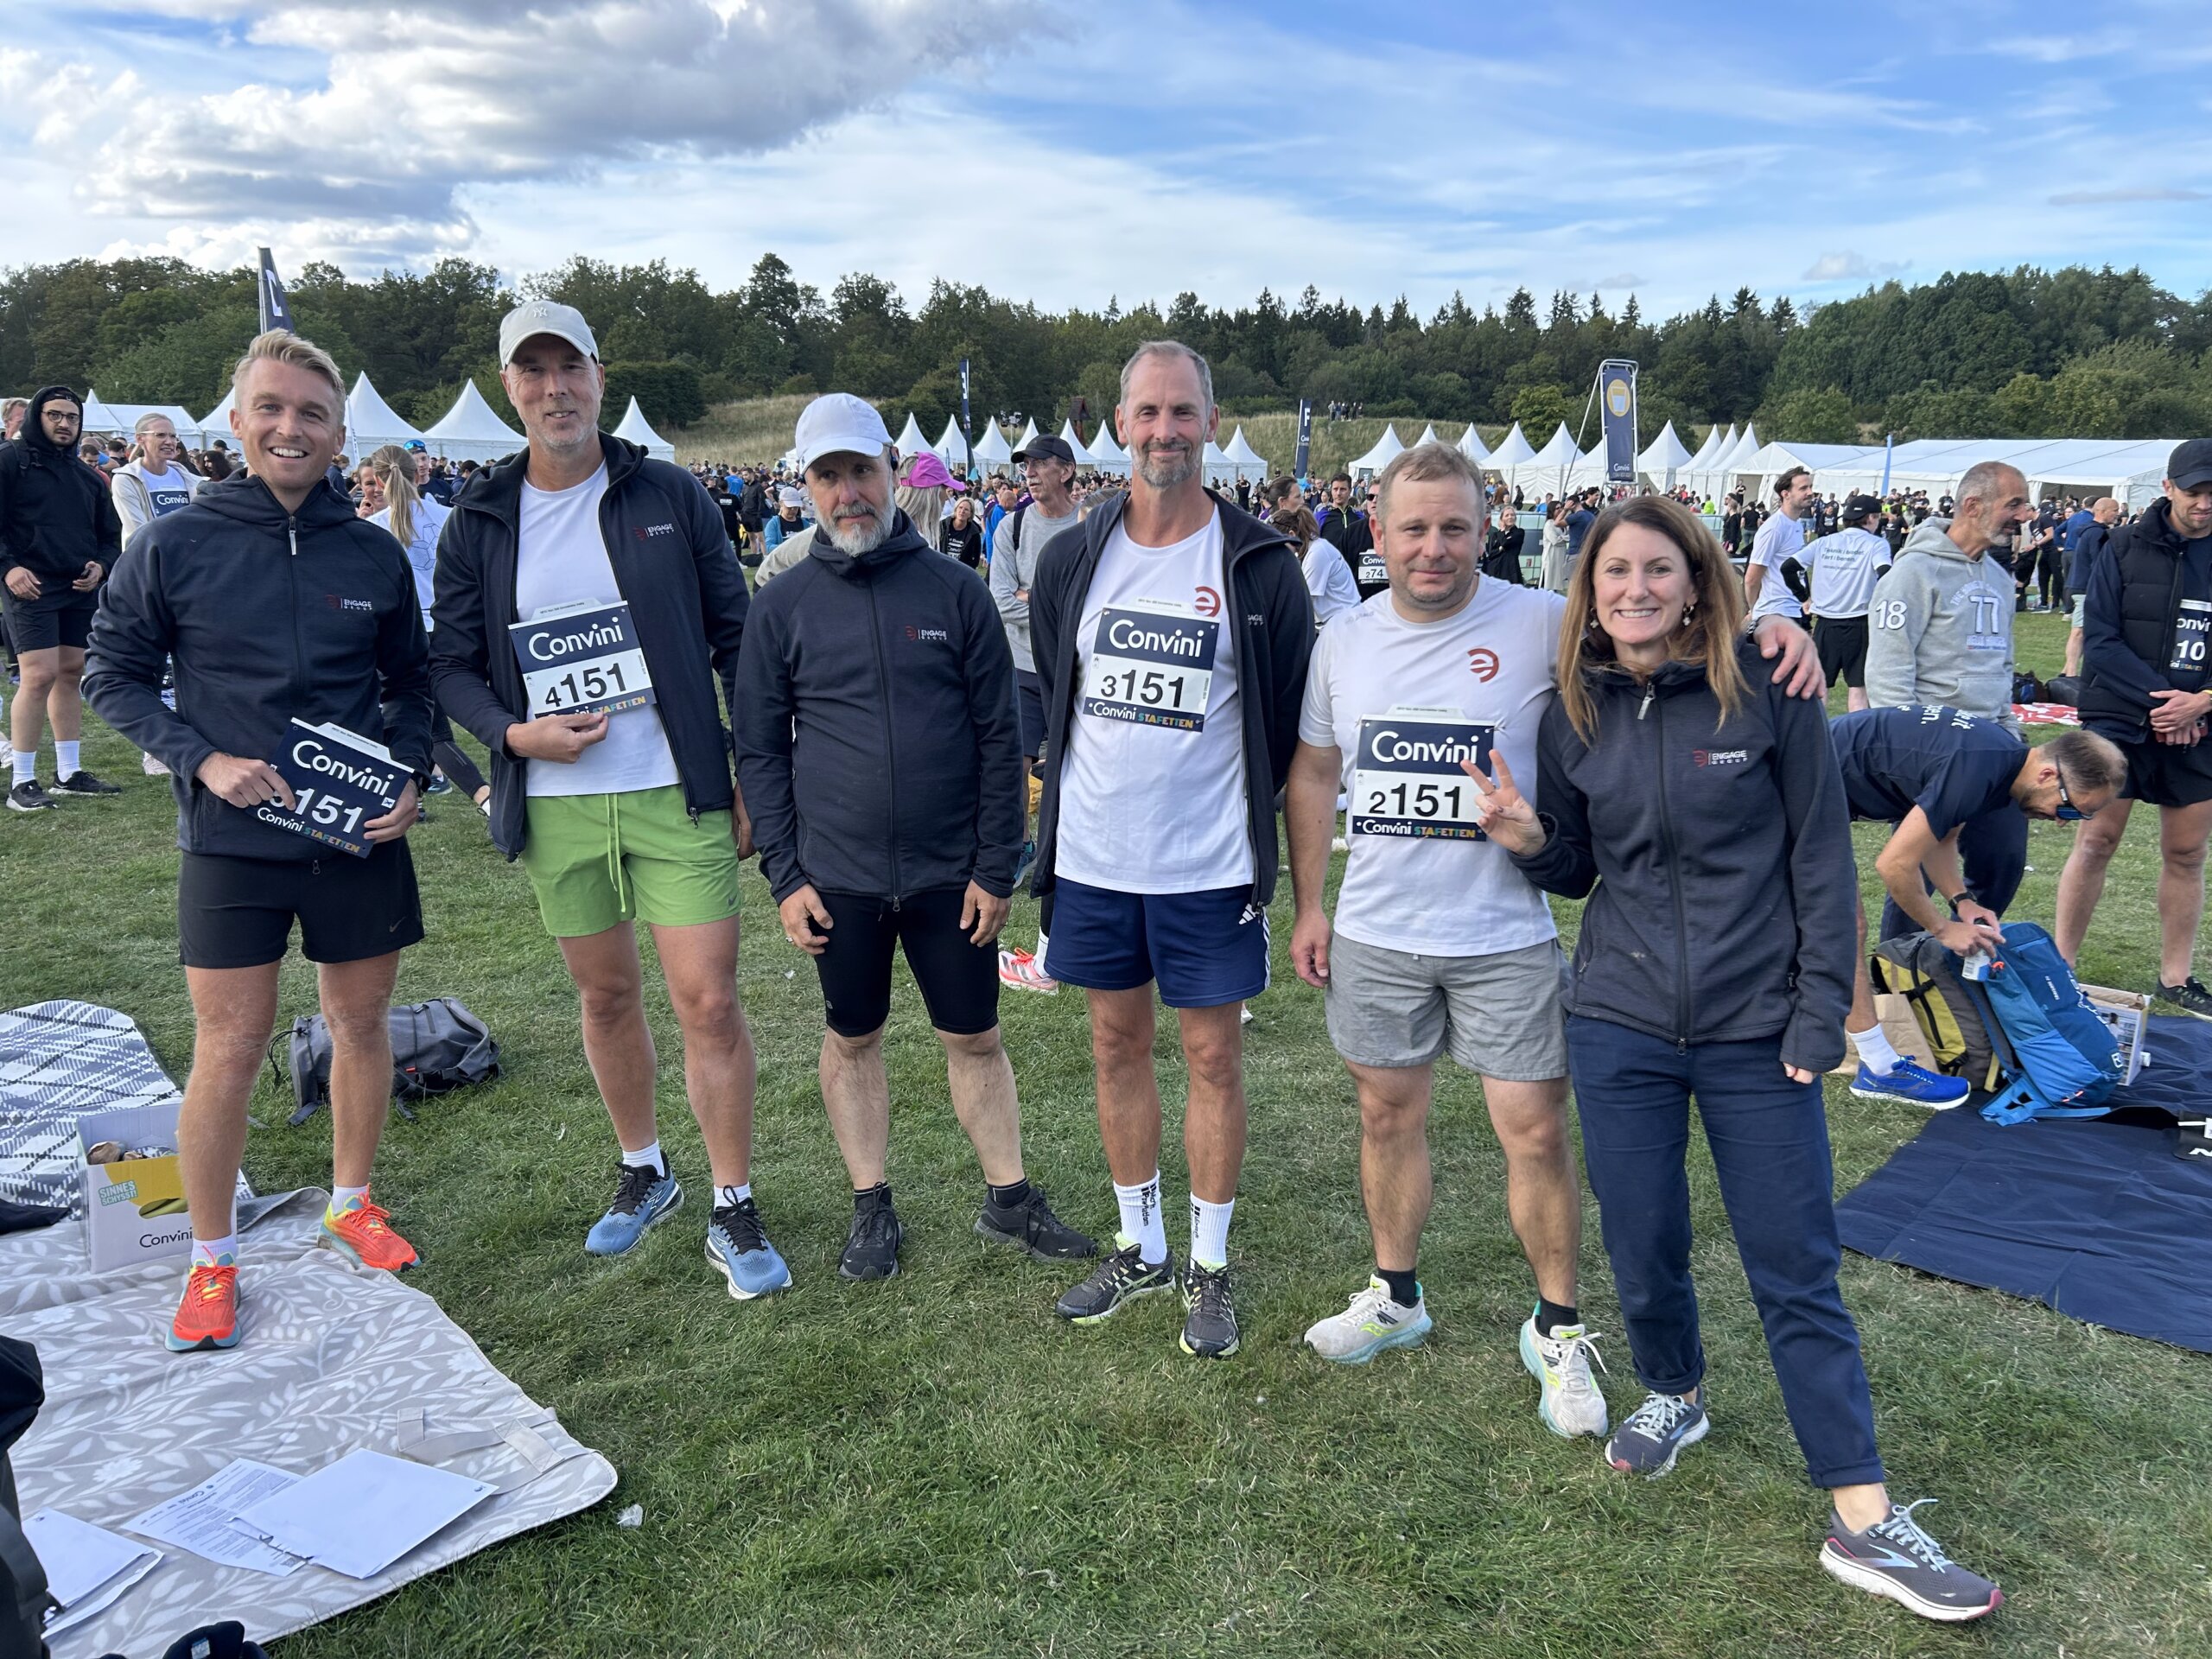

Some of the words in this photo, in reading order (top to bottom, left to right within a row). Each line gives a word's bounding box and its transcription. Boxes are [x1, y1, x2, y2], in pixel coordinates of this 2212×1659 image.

[1304, 407, 1311, 427] F
[156, 493, 189, 505] Convini
[1365, 569, 1384, 579] 274
[1876, 600, 1907, 630] 18
[1968, 595, 1999, 634] 77
[528, 616, 624, 661] Convini
[1109, 619, 1205, 658] Convini
[545, 663, 626, 708] 4151
[1100, 669, 1184, 709] 3151
[1093, 701, 1137, 721] Convini
[1137, 712, 1194, 728] STAFETTEN
[1371, 730, 1479, 765] Convini
[1712, 750, 1747, 760] ENGAGE
[292, 740, 395, 796] Convini
[1369, 783, 1460, 818] 2151
[257, 807, 305, 833] Convini
[303, 827, 360, 854] STAFETTEN
[1362, 819, 1413, 835] Convini
[1414, 825, 1476, 838] STAFETTEN
[99, 1180, 136, 1198] SINNES
[102, 1190, 137, 1205] SCHYSST!
[139, 1227, 193, 1248] Convini
